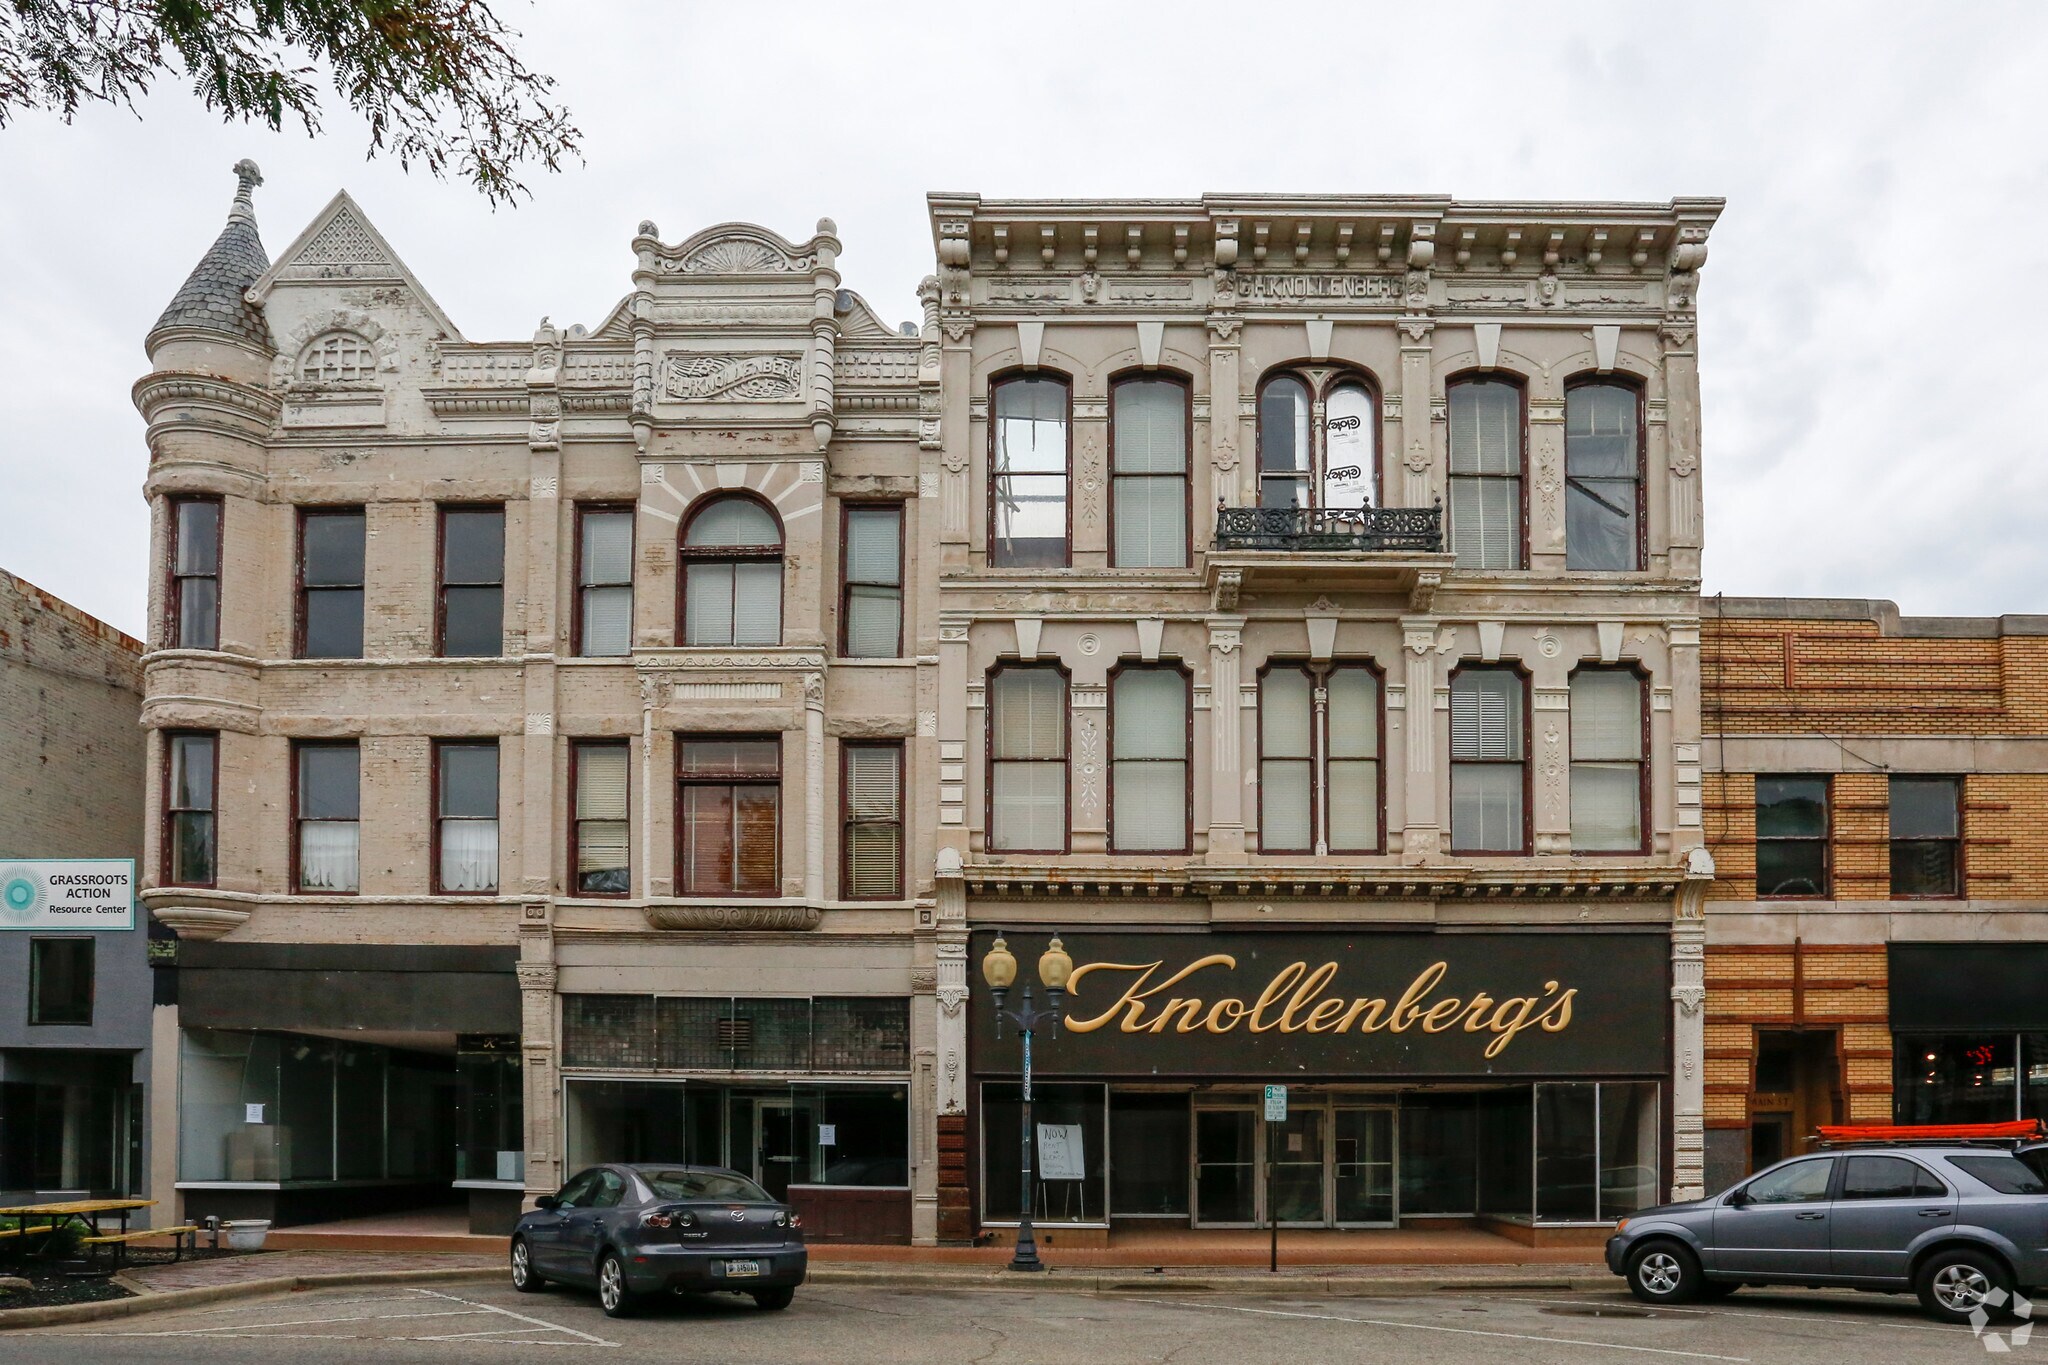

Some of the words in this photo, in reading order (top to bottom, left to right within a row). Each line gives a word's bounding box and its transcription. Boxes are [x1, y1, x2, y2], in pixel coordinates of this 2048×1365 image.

[1325, 465, 1361, 482] Celotex
[49, 874, 128, 886] GRASSROOTS
[65, 888, 111, 899] ACTION
[49, 904, 93, 914] Resource
[95, 904, 127, 914] Center
[1064, 953, 1579, 1060] Knollenberg's
[1044, 1129, 1068, 1140] NOW
